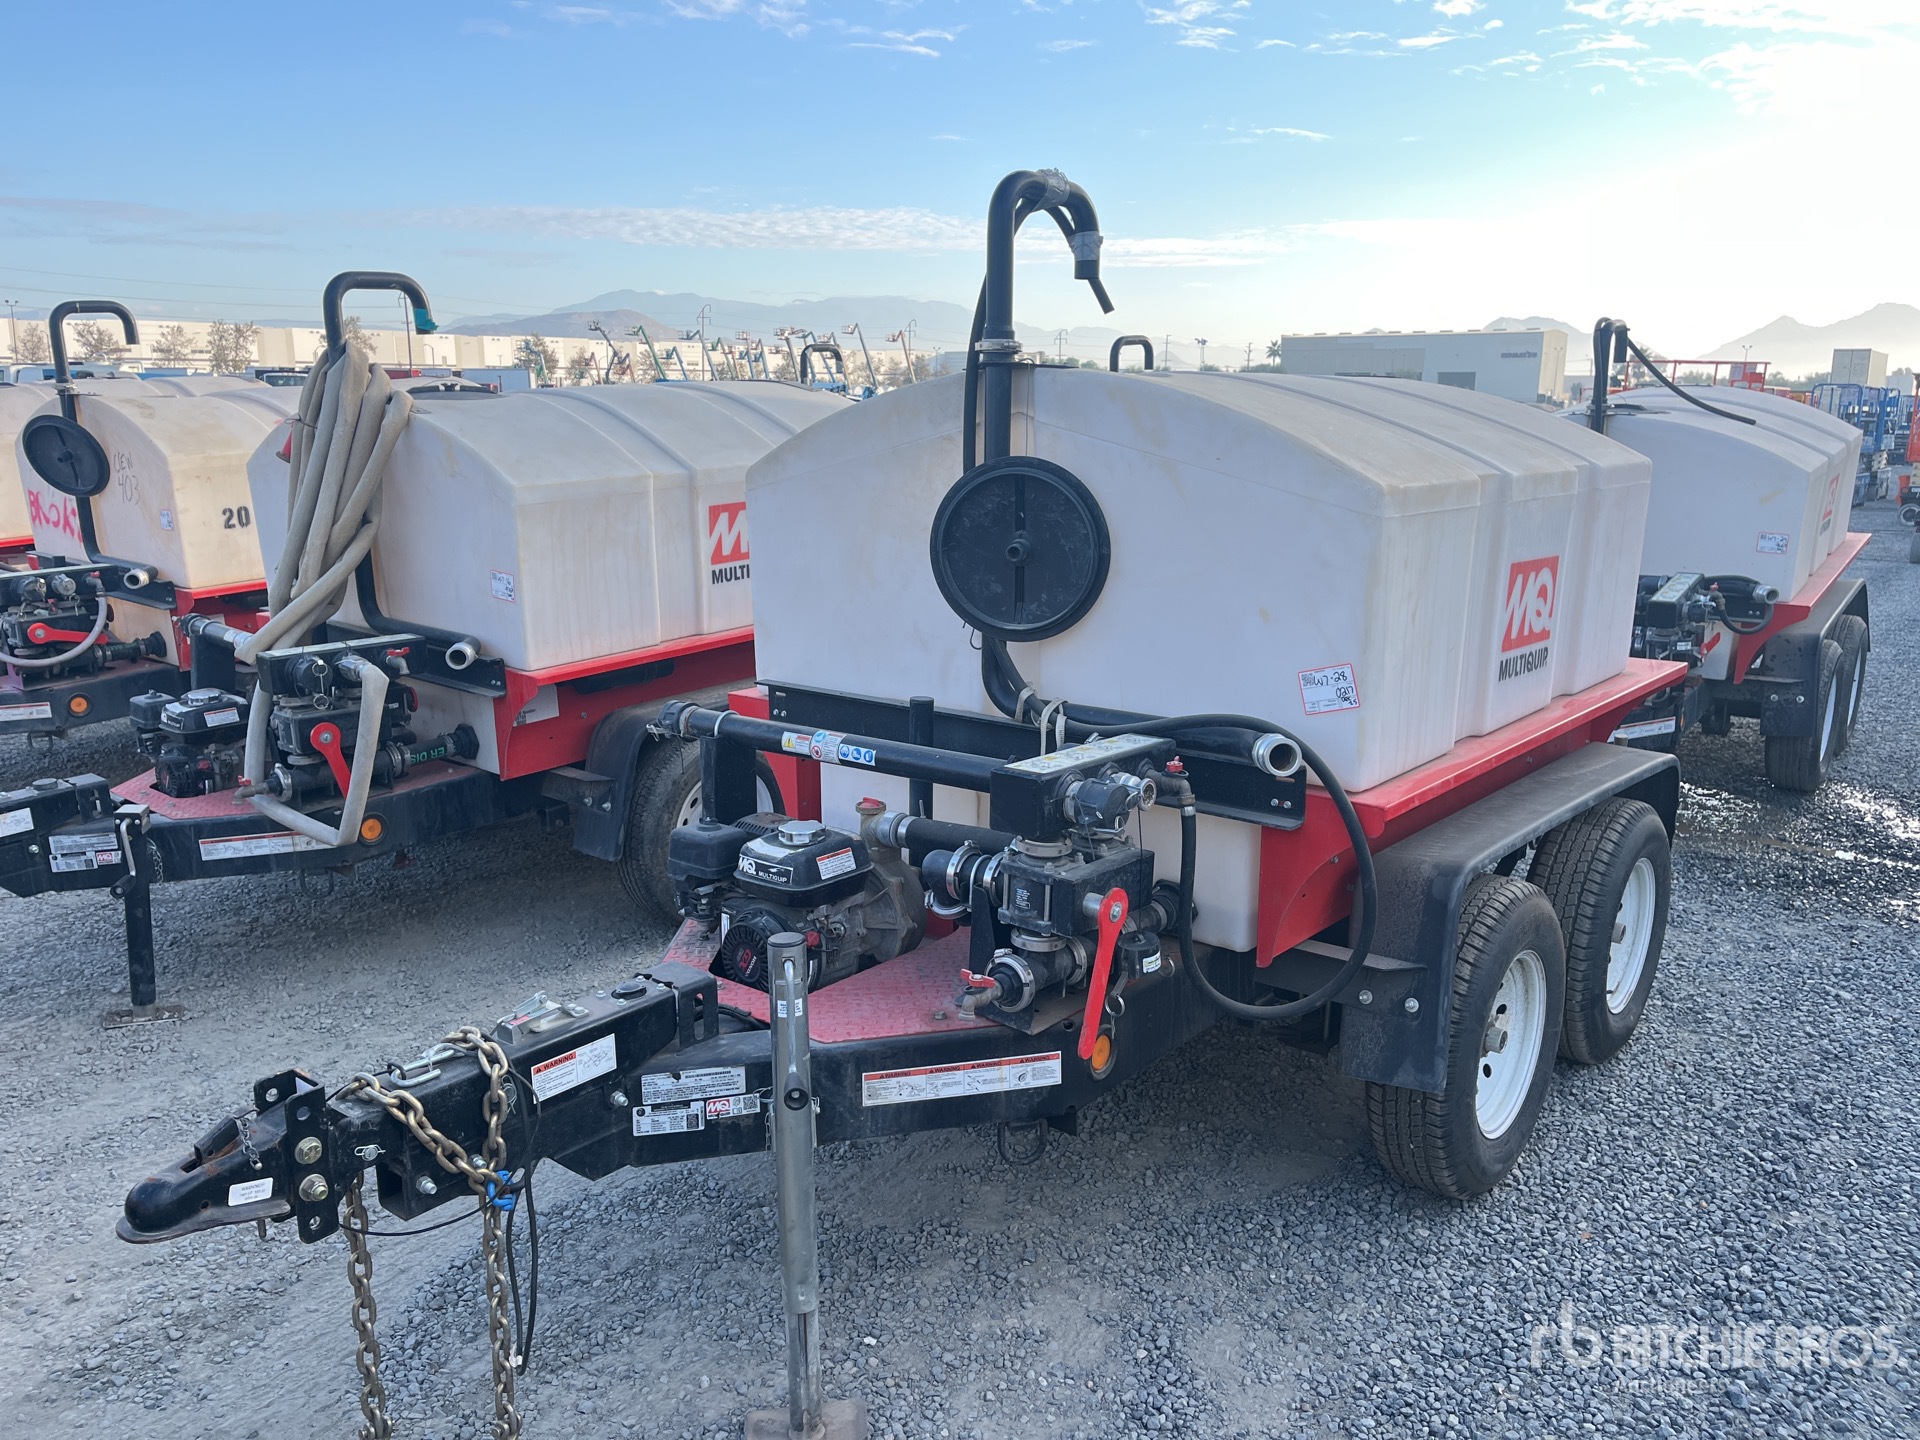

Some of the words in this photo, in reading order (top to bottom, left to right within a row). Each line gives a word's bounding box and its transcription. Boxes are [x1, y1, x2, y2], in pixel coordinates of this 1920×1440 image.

[222, 505, 251, 530] 20
[711, 563, 751, 585] MULTI
[1503, 563, 1556, 645] MQ
[1498, 646, 1549, 682] MULTIQUIP
[429, 746, 446, 759] ER
[758, 870, 788, 883] MULTIQUIP
[543, 1053, 574, 1071] WARNING
[707, 1100, 730, 1112] MQ
